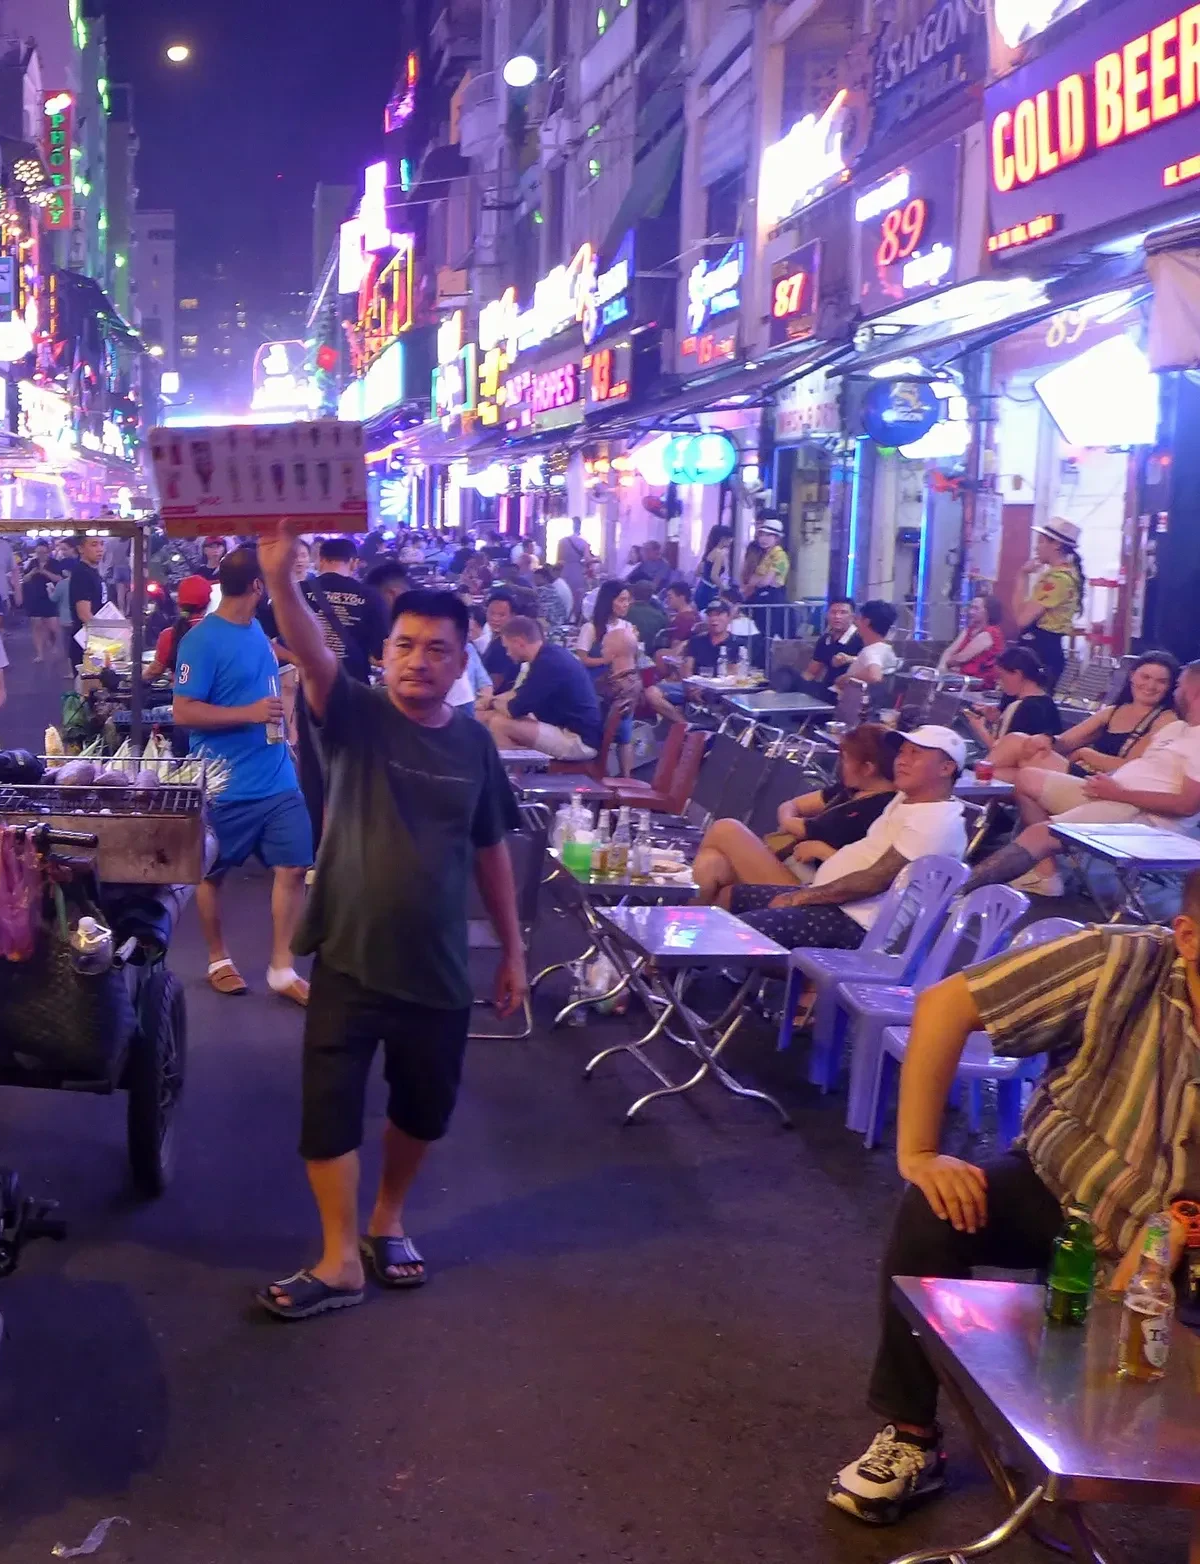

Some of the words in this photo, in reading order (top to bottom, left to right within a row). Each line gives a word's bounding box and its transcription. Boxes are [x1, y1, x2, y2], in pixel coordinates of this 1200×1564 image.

[991, 72, 1087, 193] COLD
[1093, 3, 1200, 149] BEER
[875, 198, 927, 267] 89
[773, 271, 805, 318] 87
[178, 663, 190, 685] 3
